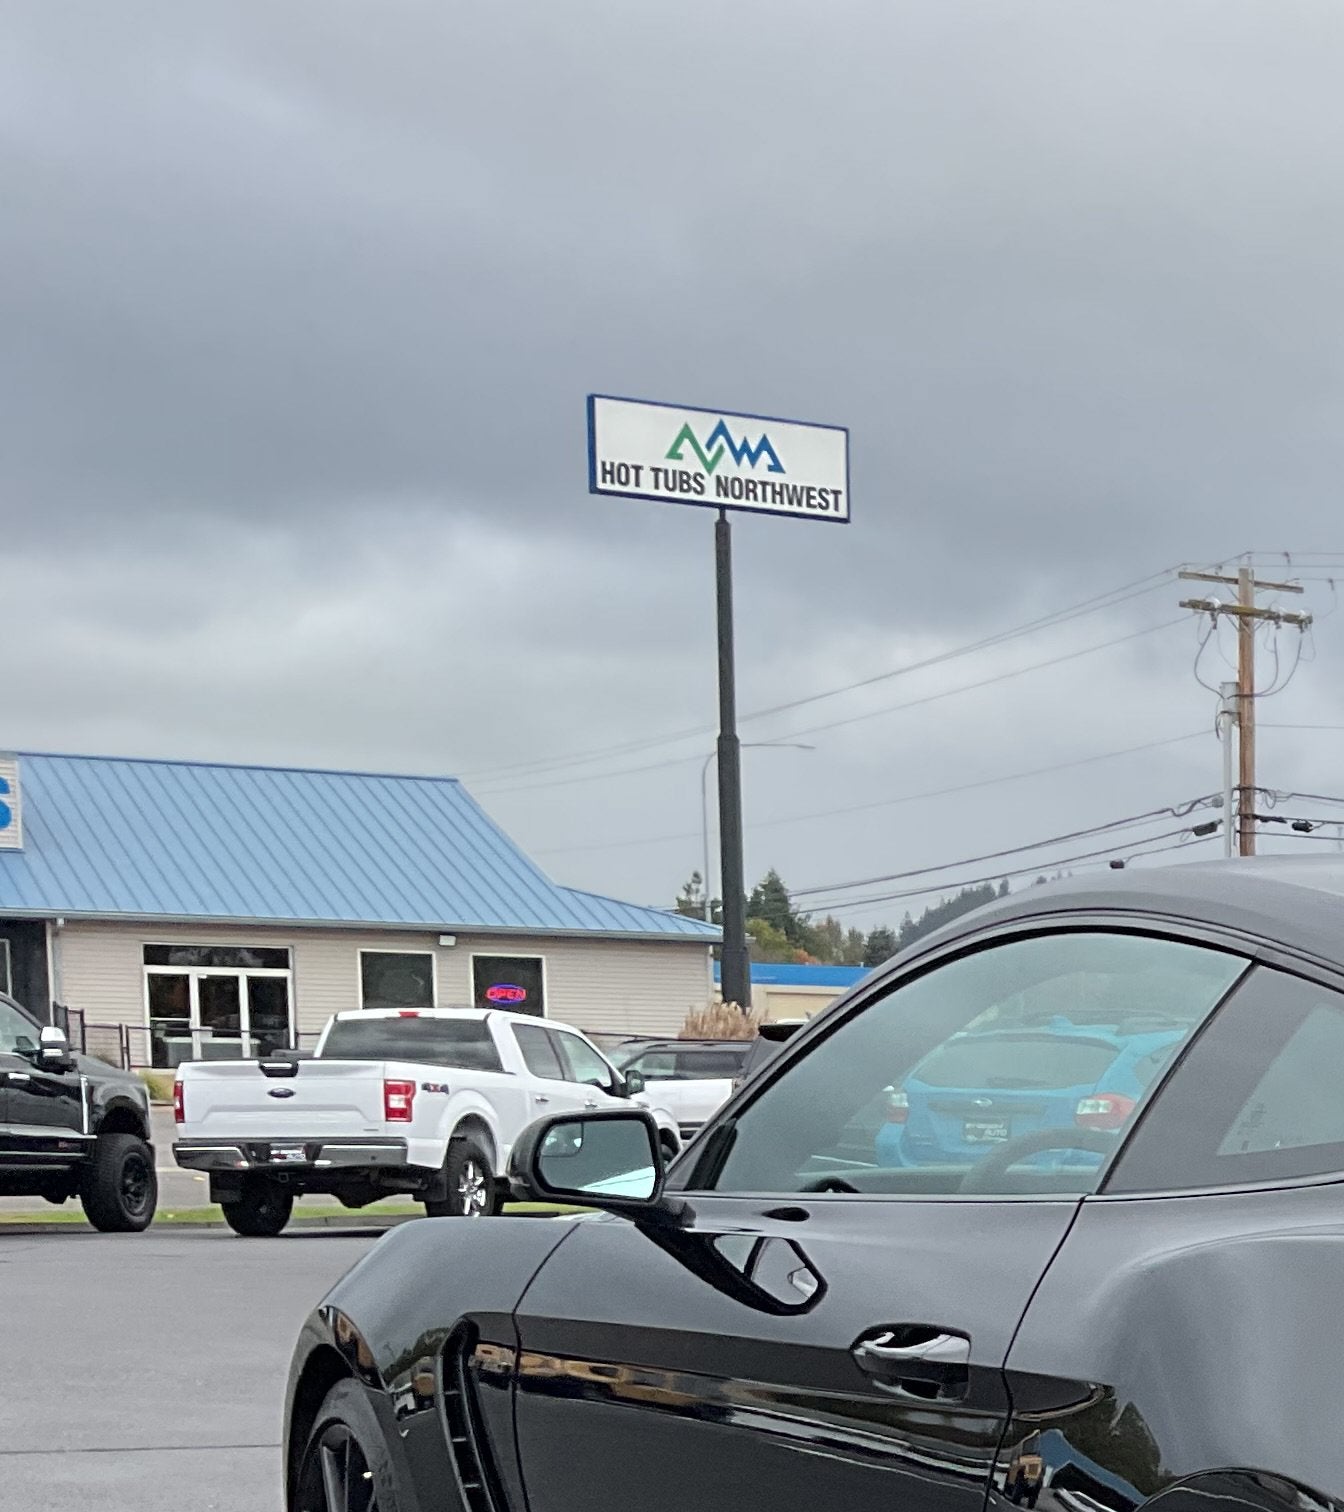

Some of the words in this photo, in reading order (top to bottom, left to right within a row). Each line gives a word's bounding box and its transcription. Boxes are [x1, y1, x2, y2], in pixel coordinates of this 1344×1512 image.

[601, 461, 644, 488] HOT
[650, 466, 705, 496] TUBS
[715, 474, 843, 512] NORTHWEST
